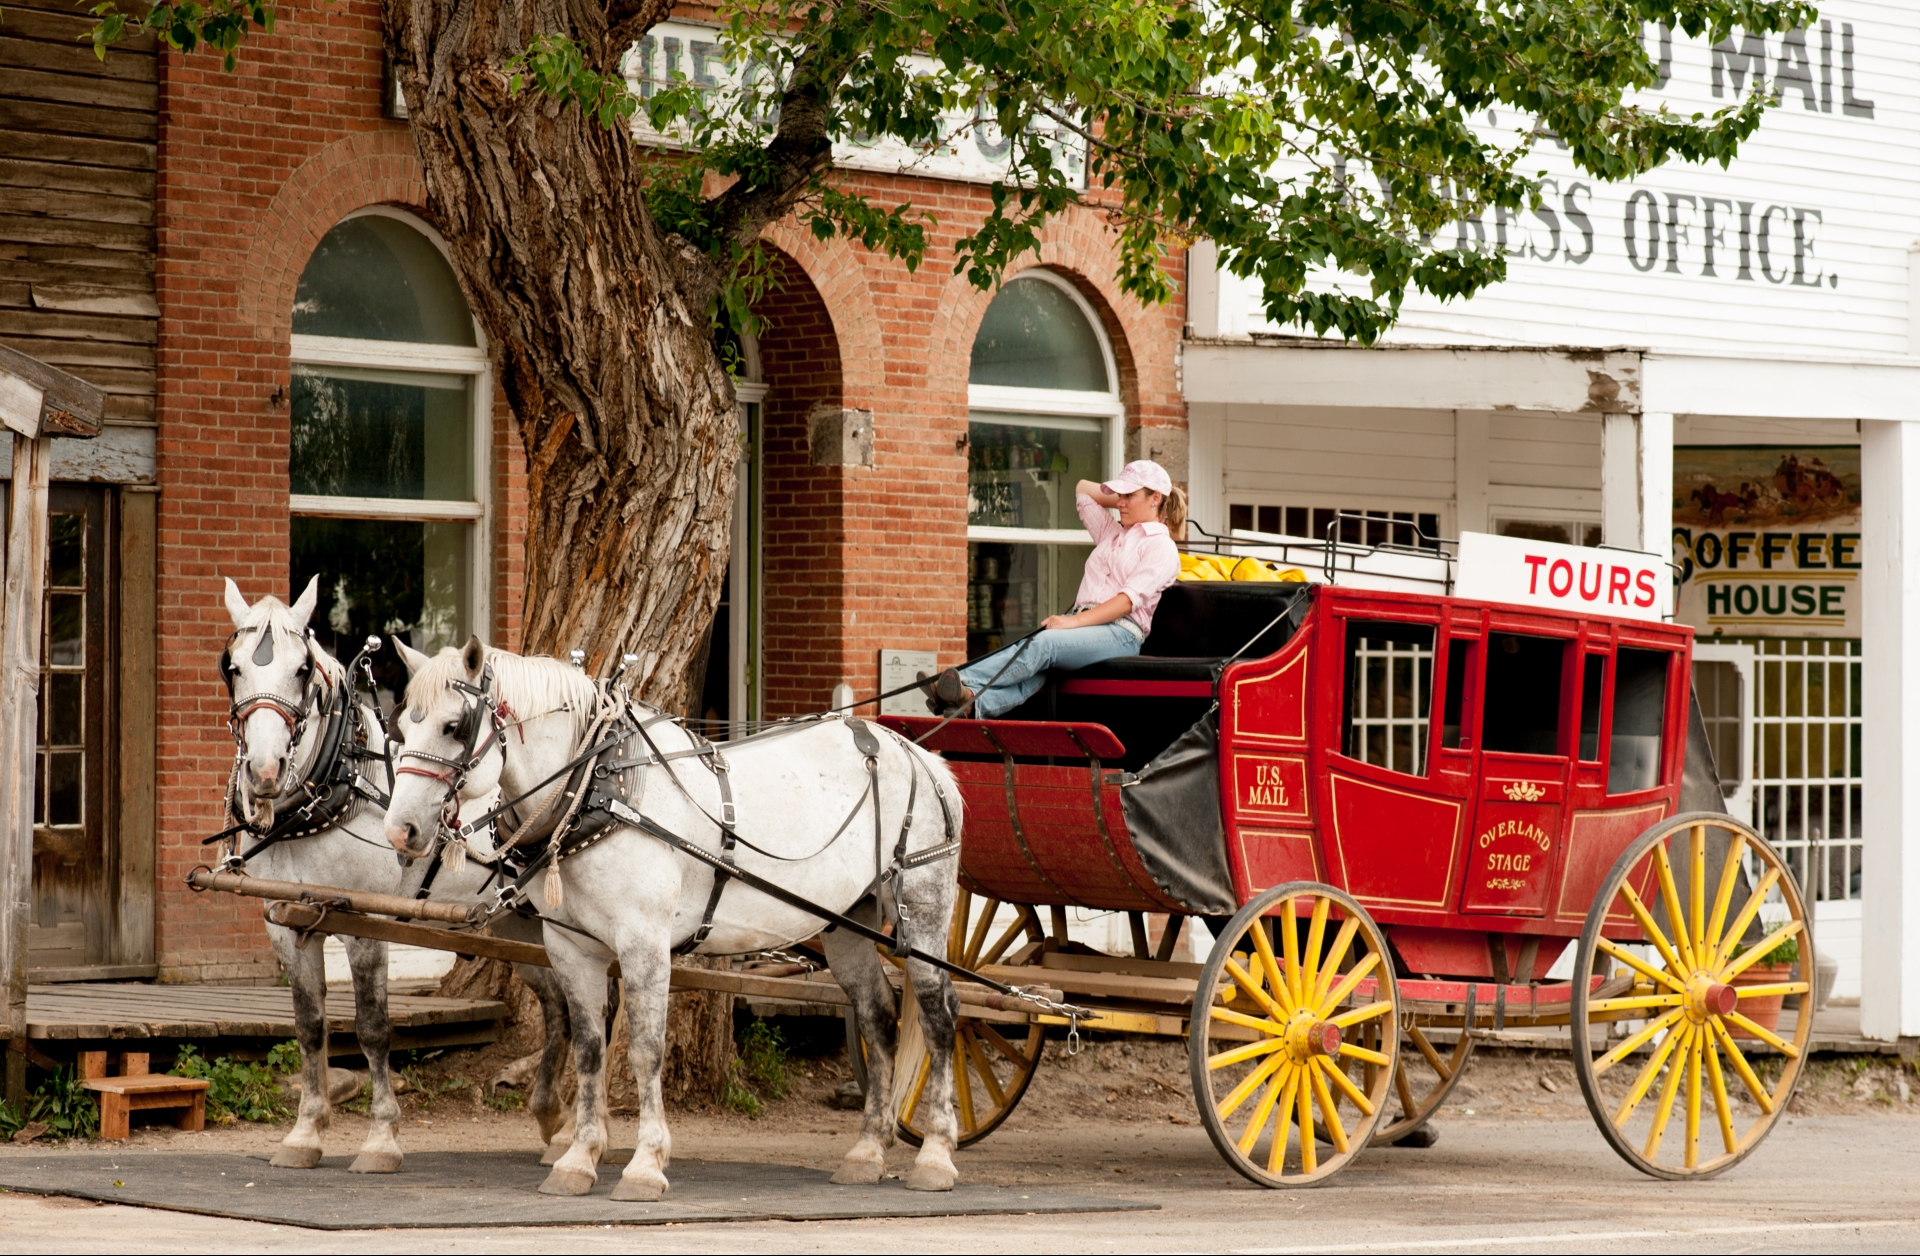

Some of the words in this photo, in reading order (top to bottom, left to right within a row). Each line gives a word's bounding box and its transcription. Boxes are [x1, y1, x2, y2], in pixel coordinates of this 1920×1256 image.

[1711, 19, 1875, 120] MAIL
[1623, 189, 1839, 290] OFFICE.
[1673, 527, 1862, 586] COFFEE
[1524, 554, 1656, 608] TOURS
[1707, 584, 1846, 616] HOUSE
[1256, 765, 1284, 786] U.S.
[1248, 786, 1289, 807] MAIL
[1480, 820, 1551, 852] OVERLAND
[1487, 853, 1531, 872] STAGE
